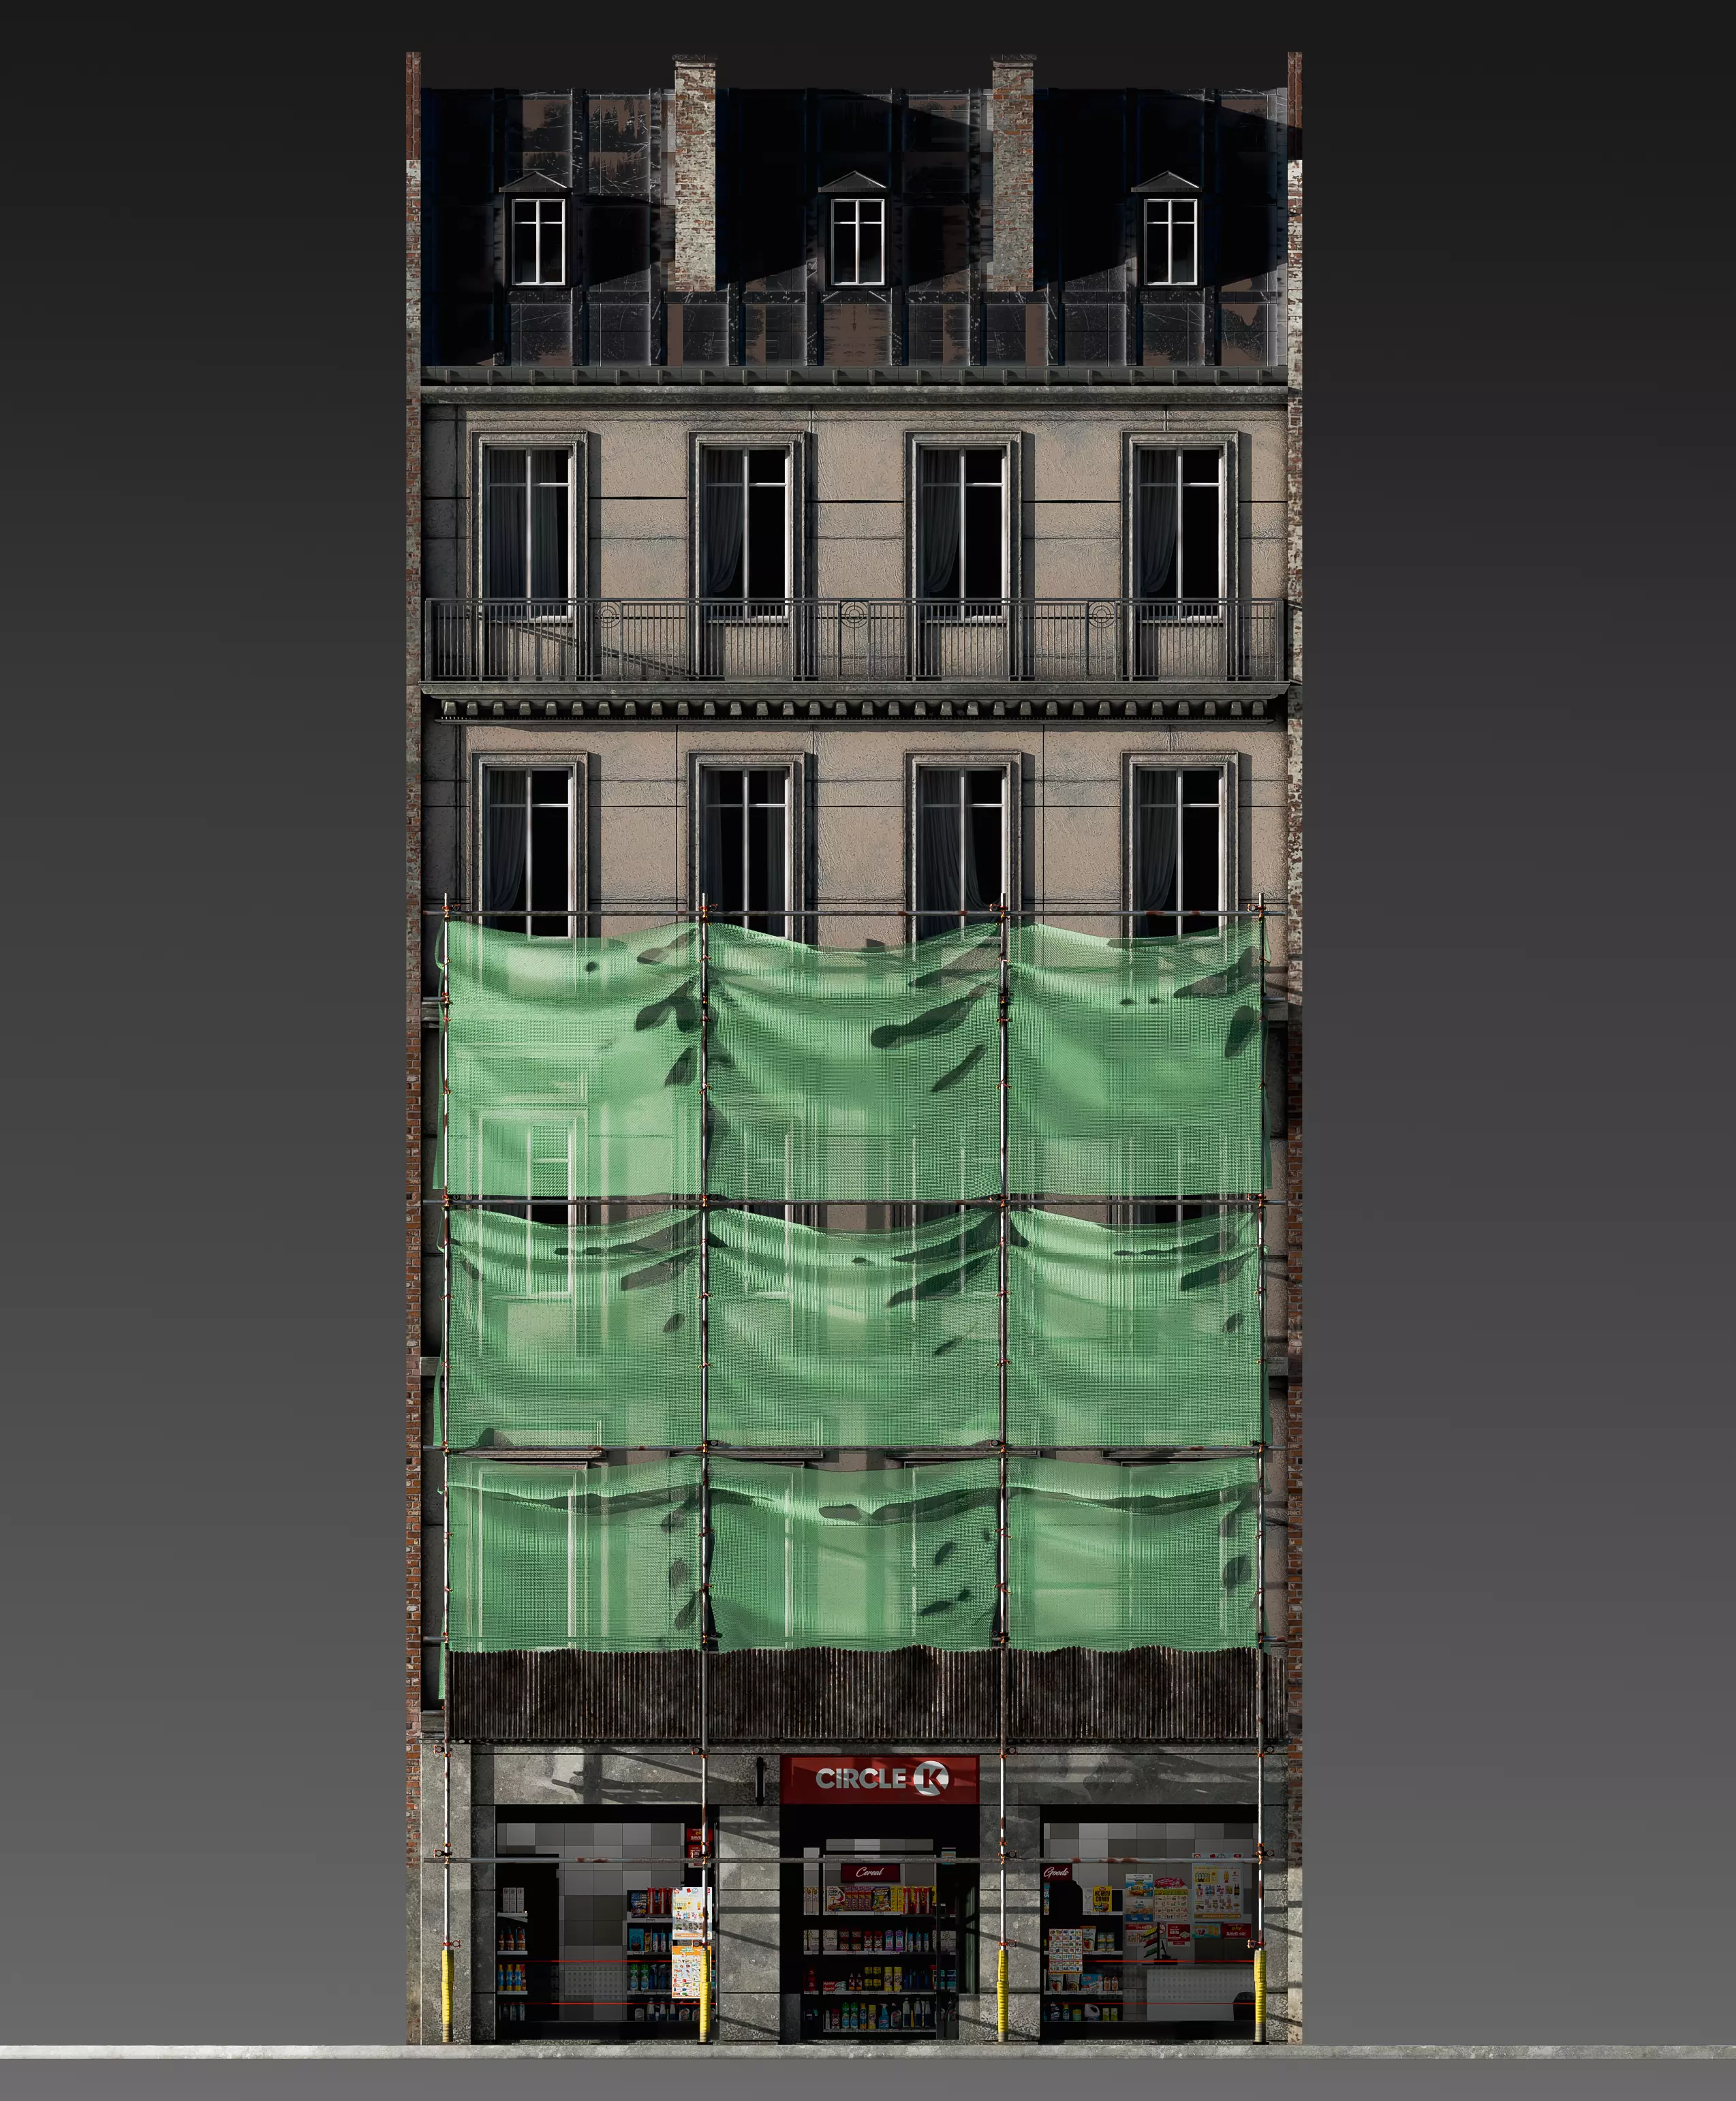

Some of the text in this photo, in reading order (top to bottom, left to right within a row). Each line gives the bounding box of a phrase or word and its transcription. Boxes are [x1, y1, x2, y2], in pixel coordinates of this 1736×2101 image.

[816, 1768, 906, 1789] CIRCLE
[856, 1867, 884, 1878] Cereal
[1043, 1867, 1070, 1879] Goods
